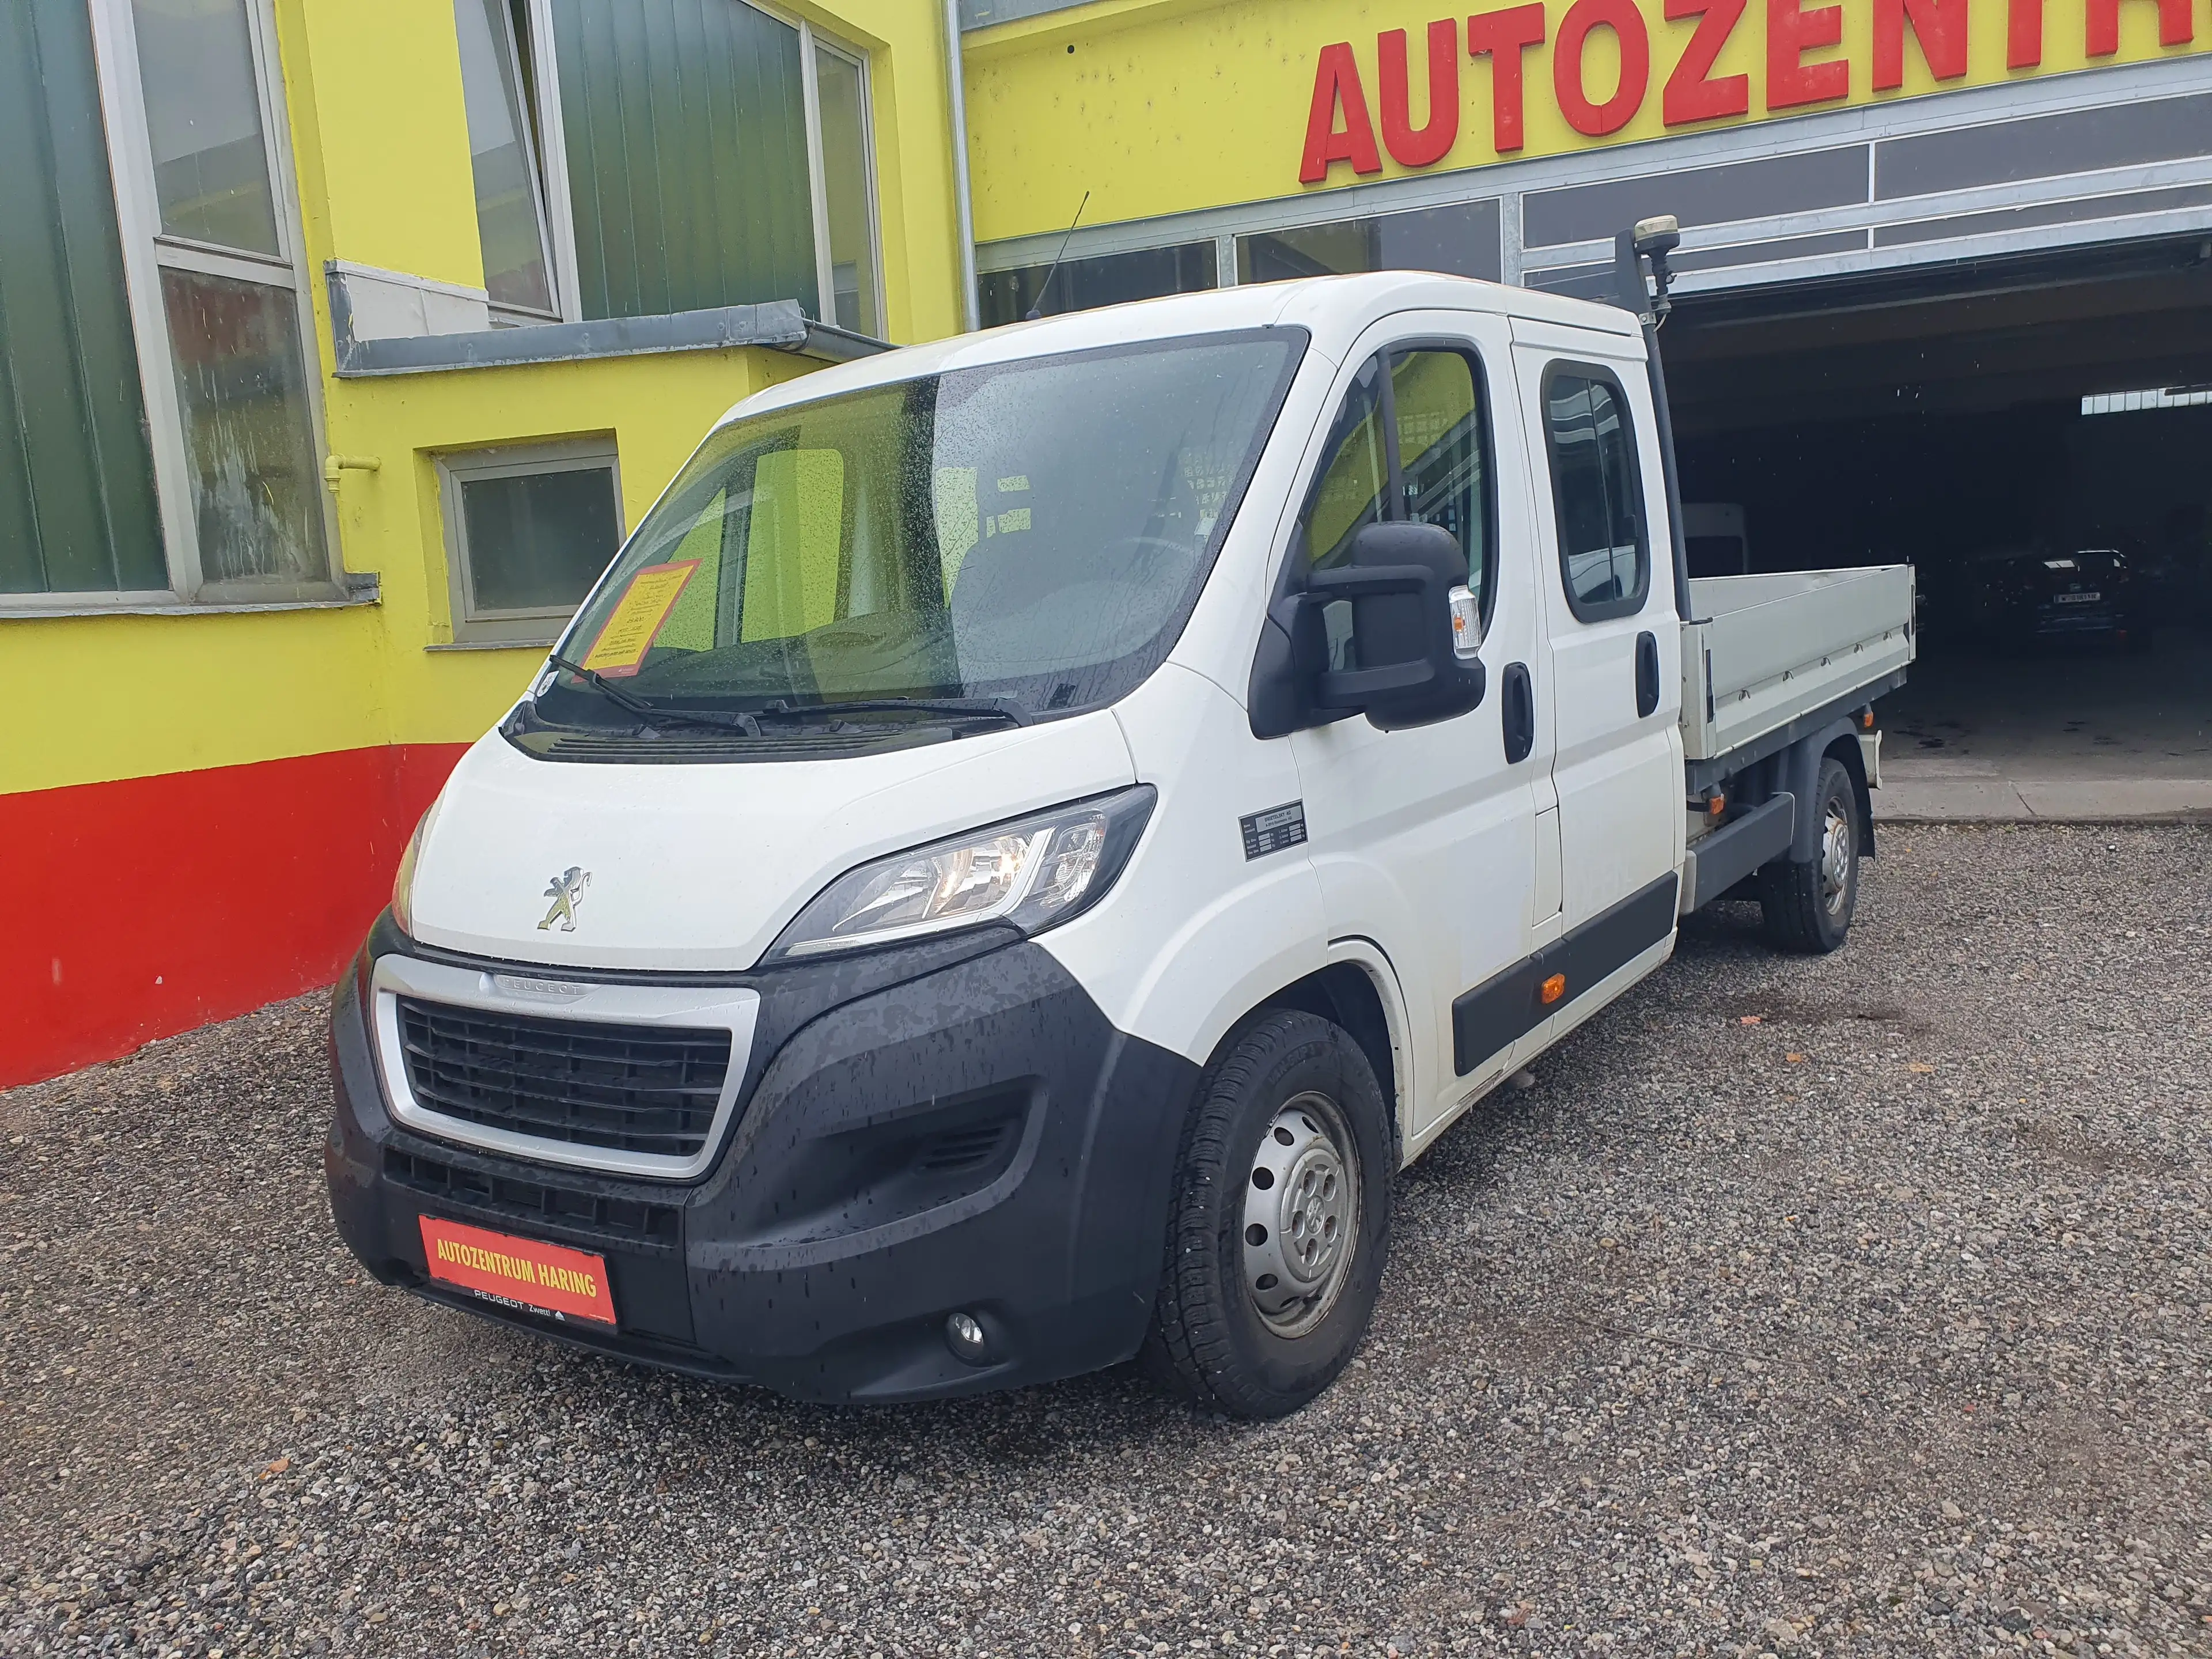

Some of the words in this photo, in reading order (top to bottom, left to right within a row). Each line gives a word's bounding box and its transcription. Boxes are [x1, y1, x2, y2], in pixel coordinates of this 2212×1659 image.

[502, 978, 579, 994] PEUGEOT
[437, 1238, 536, 1283] AUTOZENTRUM
[537, 1263, 597, 1297] HARING
[474, 1289, 524, 1309] PEUGEOT
[528, 1304, 551, 1316] Zwettl
